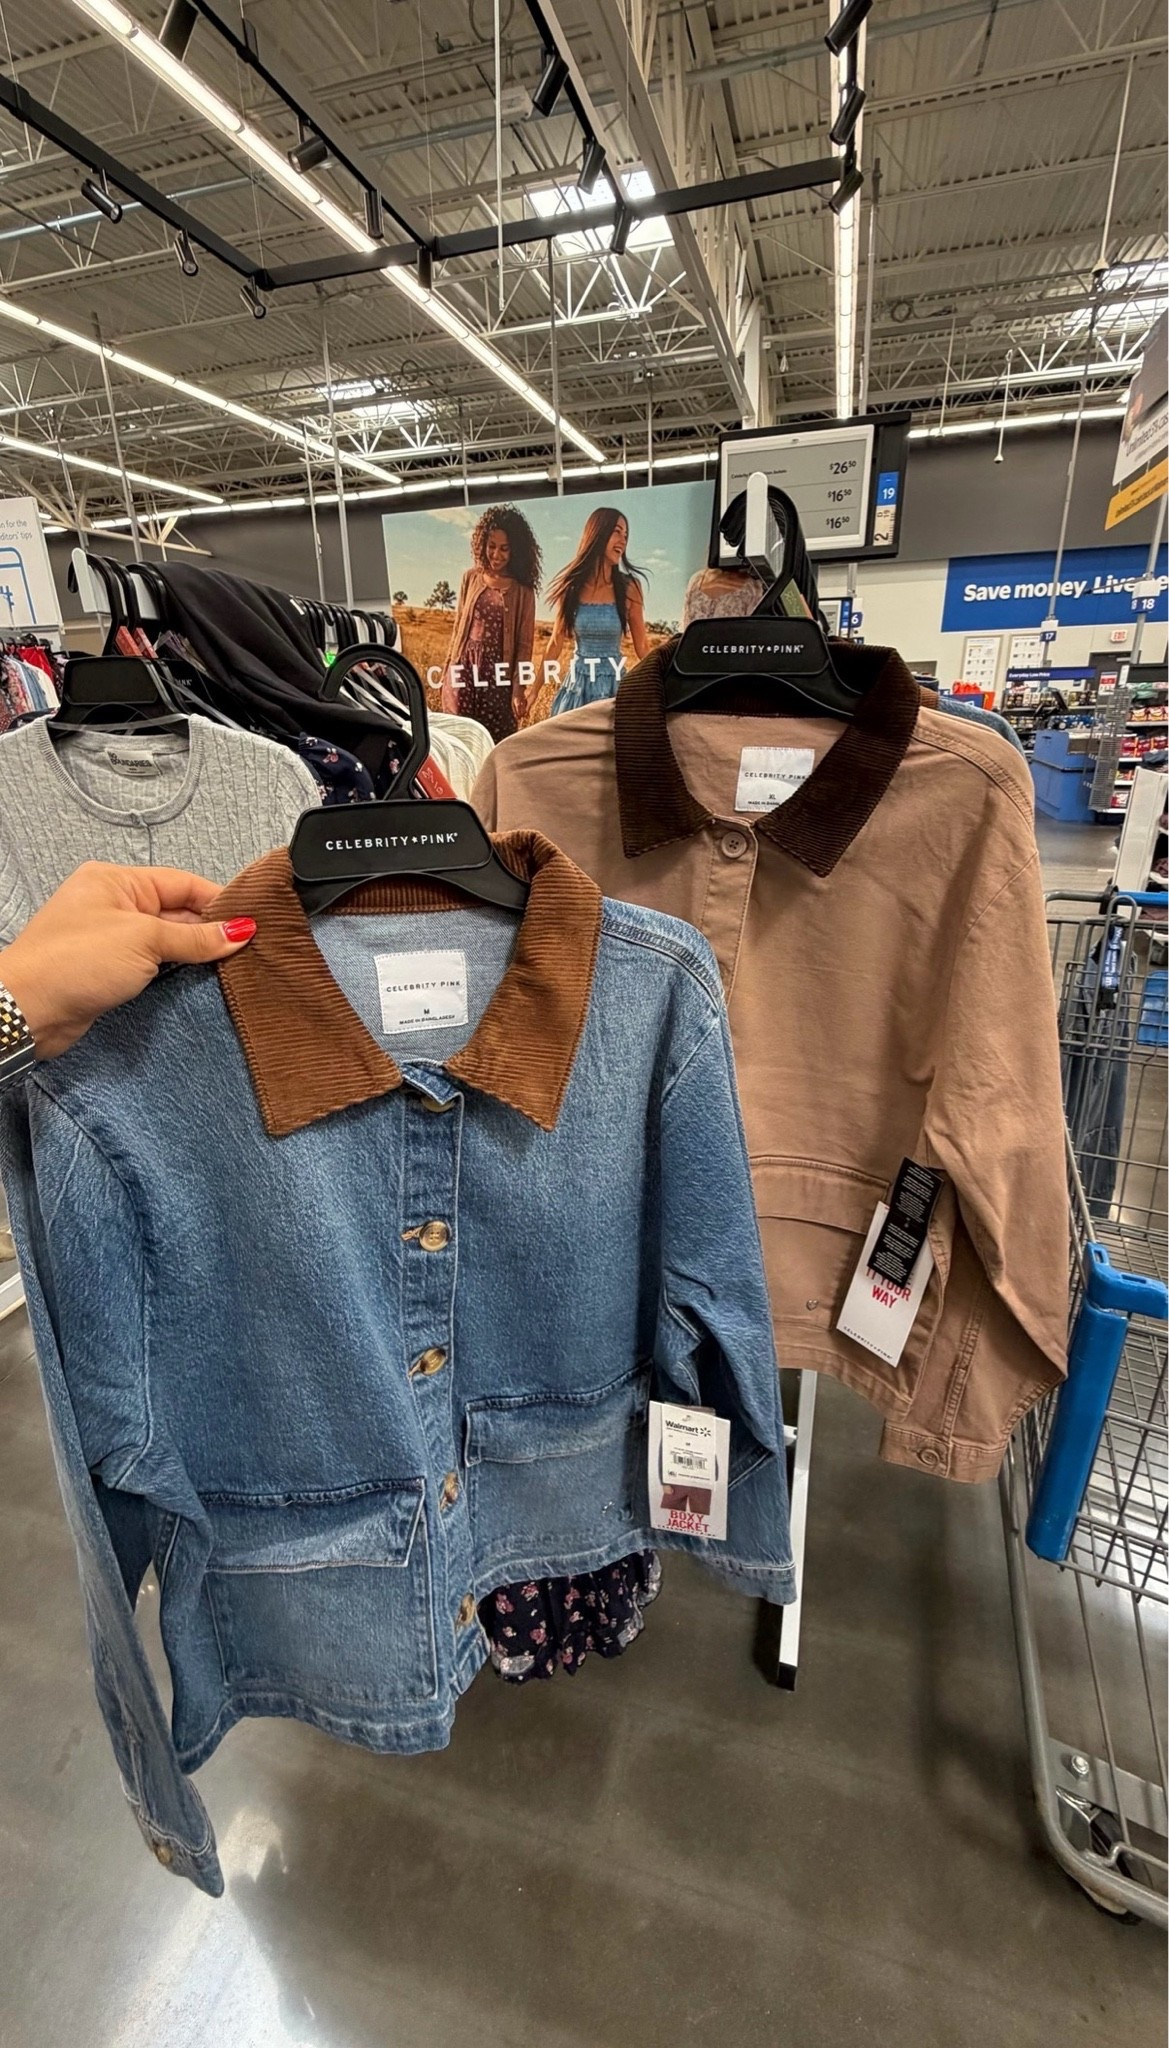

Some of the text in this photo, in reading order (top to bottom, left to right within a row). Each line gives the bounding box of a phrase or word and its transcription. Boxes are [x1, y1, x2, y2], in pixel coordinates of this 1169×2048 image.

[883, 488, 895, 500] 19
[964, 584, 1011, 601] Save
[1092, 575, 1135, 594] Live
[1142, 598, 1155, 610] 18
[1045, 632, 1054, 641] 17
[702, 645, 801, 654] CELEBRITY PINK
[426, 657, 628, 689] CELEBRITY
[326, 833, 455, 850] CELEBRITY PINK
[386, 982, 436, 993] CELEBRITY
[872, 1284, 897, 1308] WAY
[665, 1419, 699, 1433] Walmart
[670, 1510, 704, 1523] BOXY
[667, 1519, 710, 1533] JACKET
